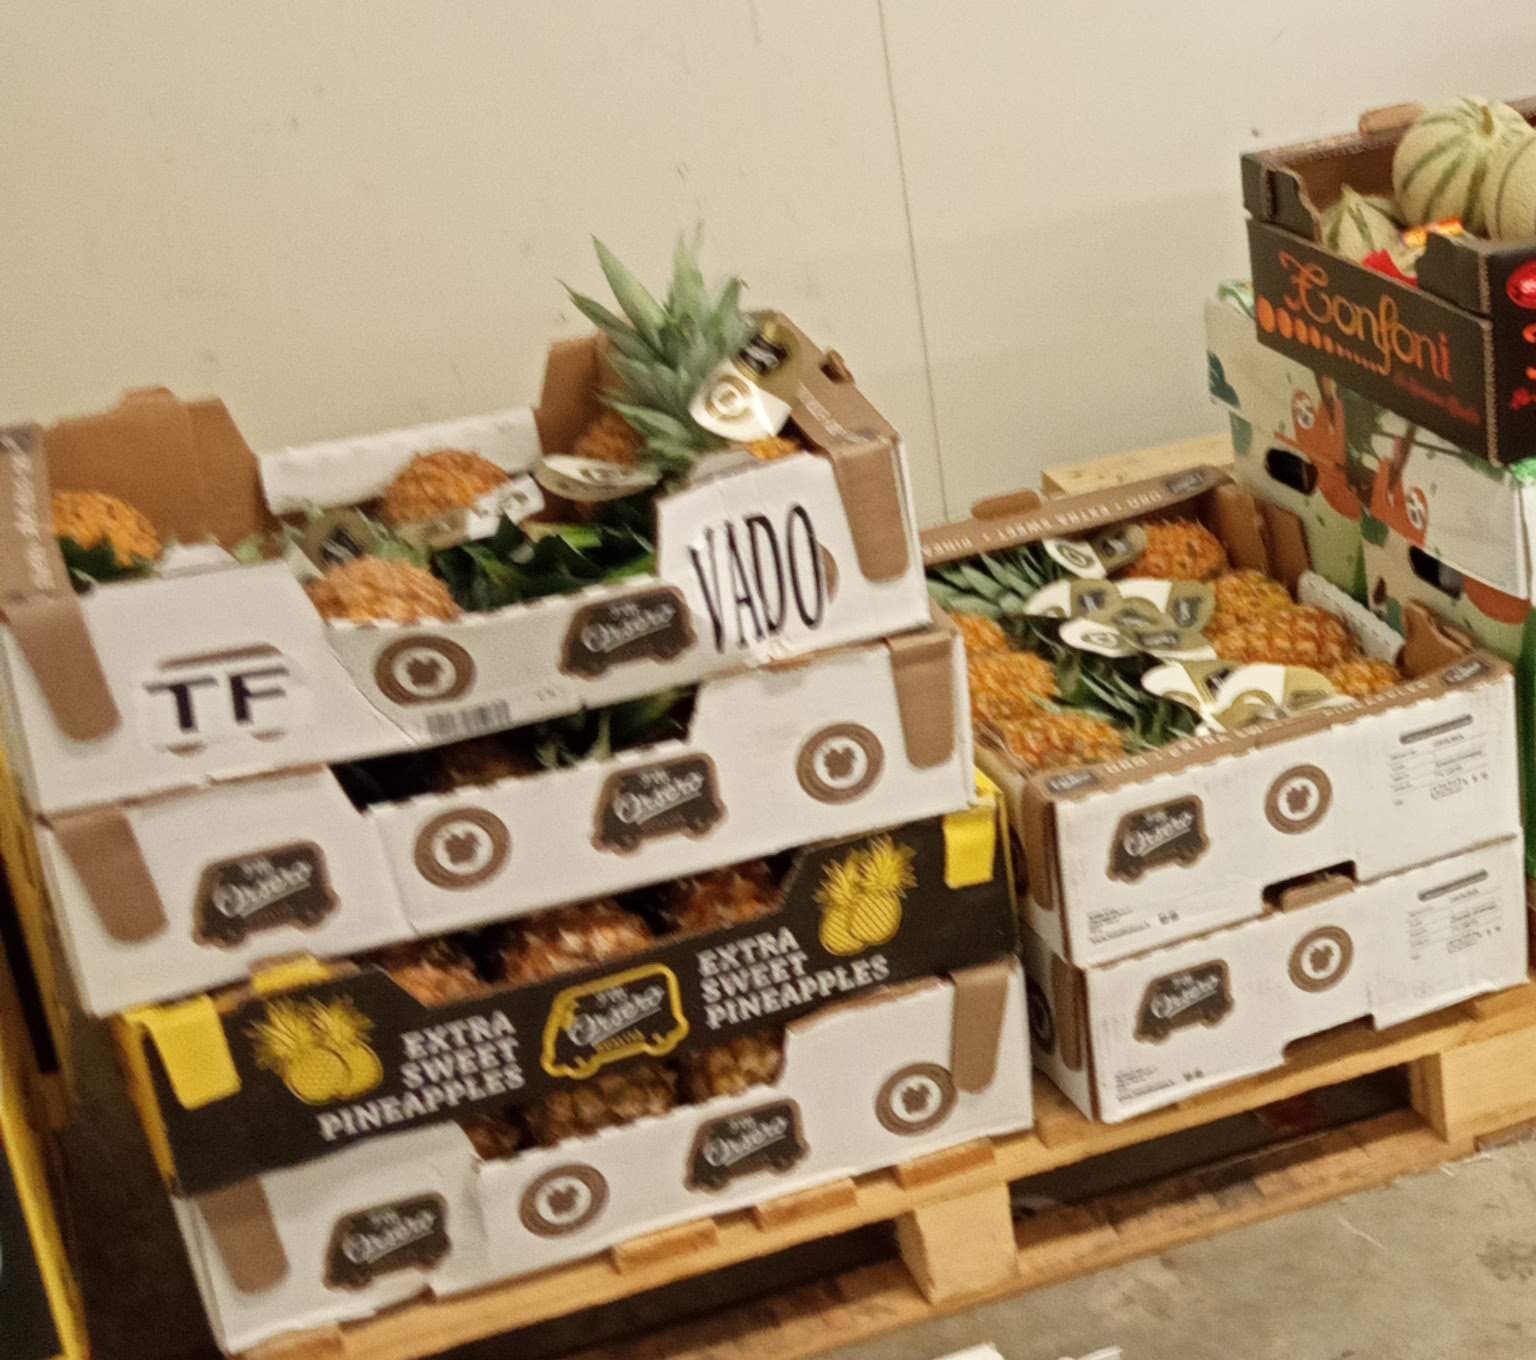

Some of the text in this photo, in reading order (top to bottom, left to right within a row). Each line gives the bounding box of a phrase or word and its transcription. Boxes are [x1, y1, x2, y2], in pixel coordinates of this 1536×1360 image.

[696, 925, 800, 977] EXTRA
[700, 950, 808, 1004] SWEET
[704, 953, 890, 1030] PINEAPPLES
[400, 1009, 517, 1060] EXTRA
[400, 1036, 520, 1090] SWEET
[316, 1062, 526, 1141] PINEAPPLES
